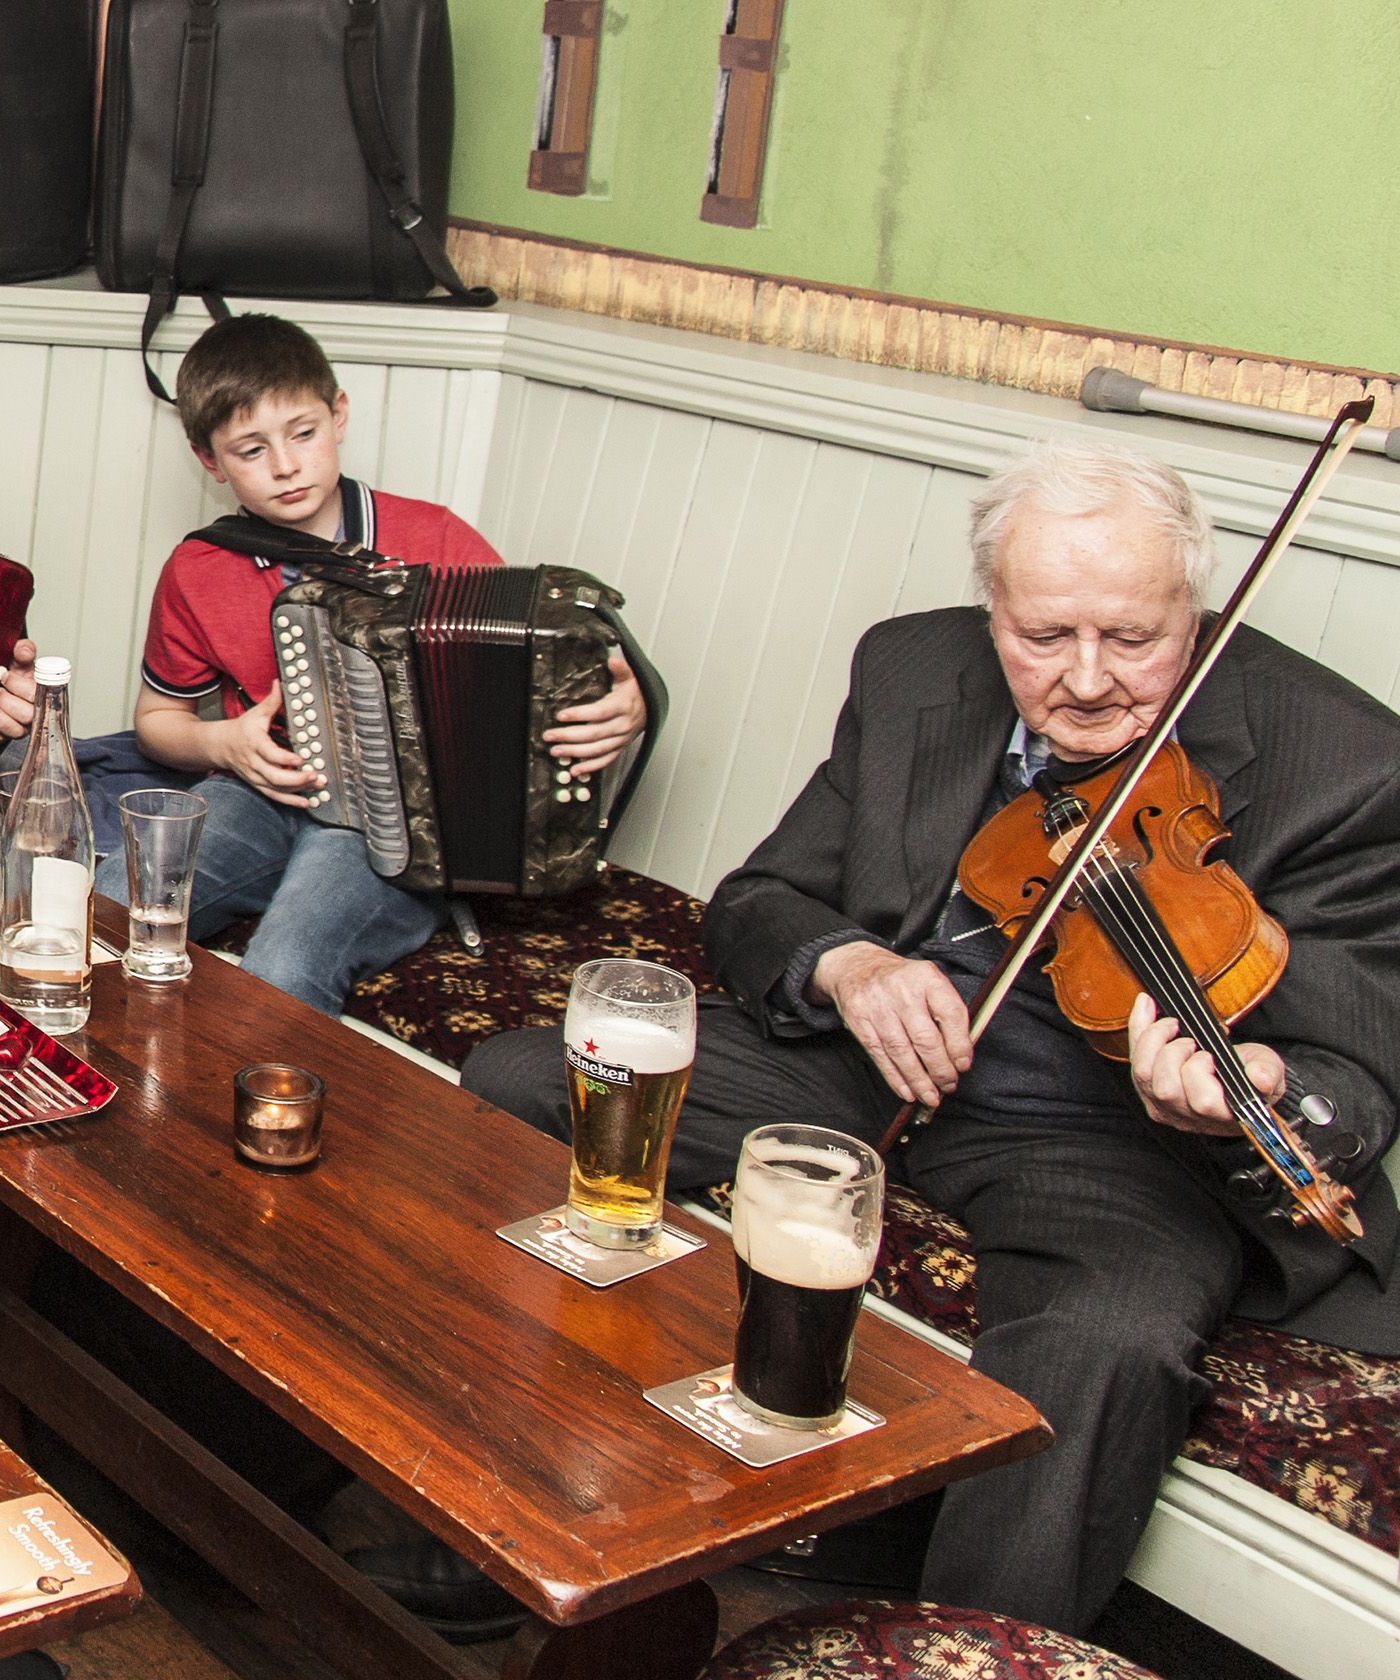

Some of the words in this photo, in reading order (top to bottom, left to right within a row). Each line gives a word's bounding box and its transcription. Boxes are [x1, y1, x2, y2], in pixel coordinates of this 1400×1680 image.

[565, 1045, 629, 1082] Heineken
[7, 1523, 61, 1572] Smooth
[21, 1506, 93, 1576] Refreshingly
